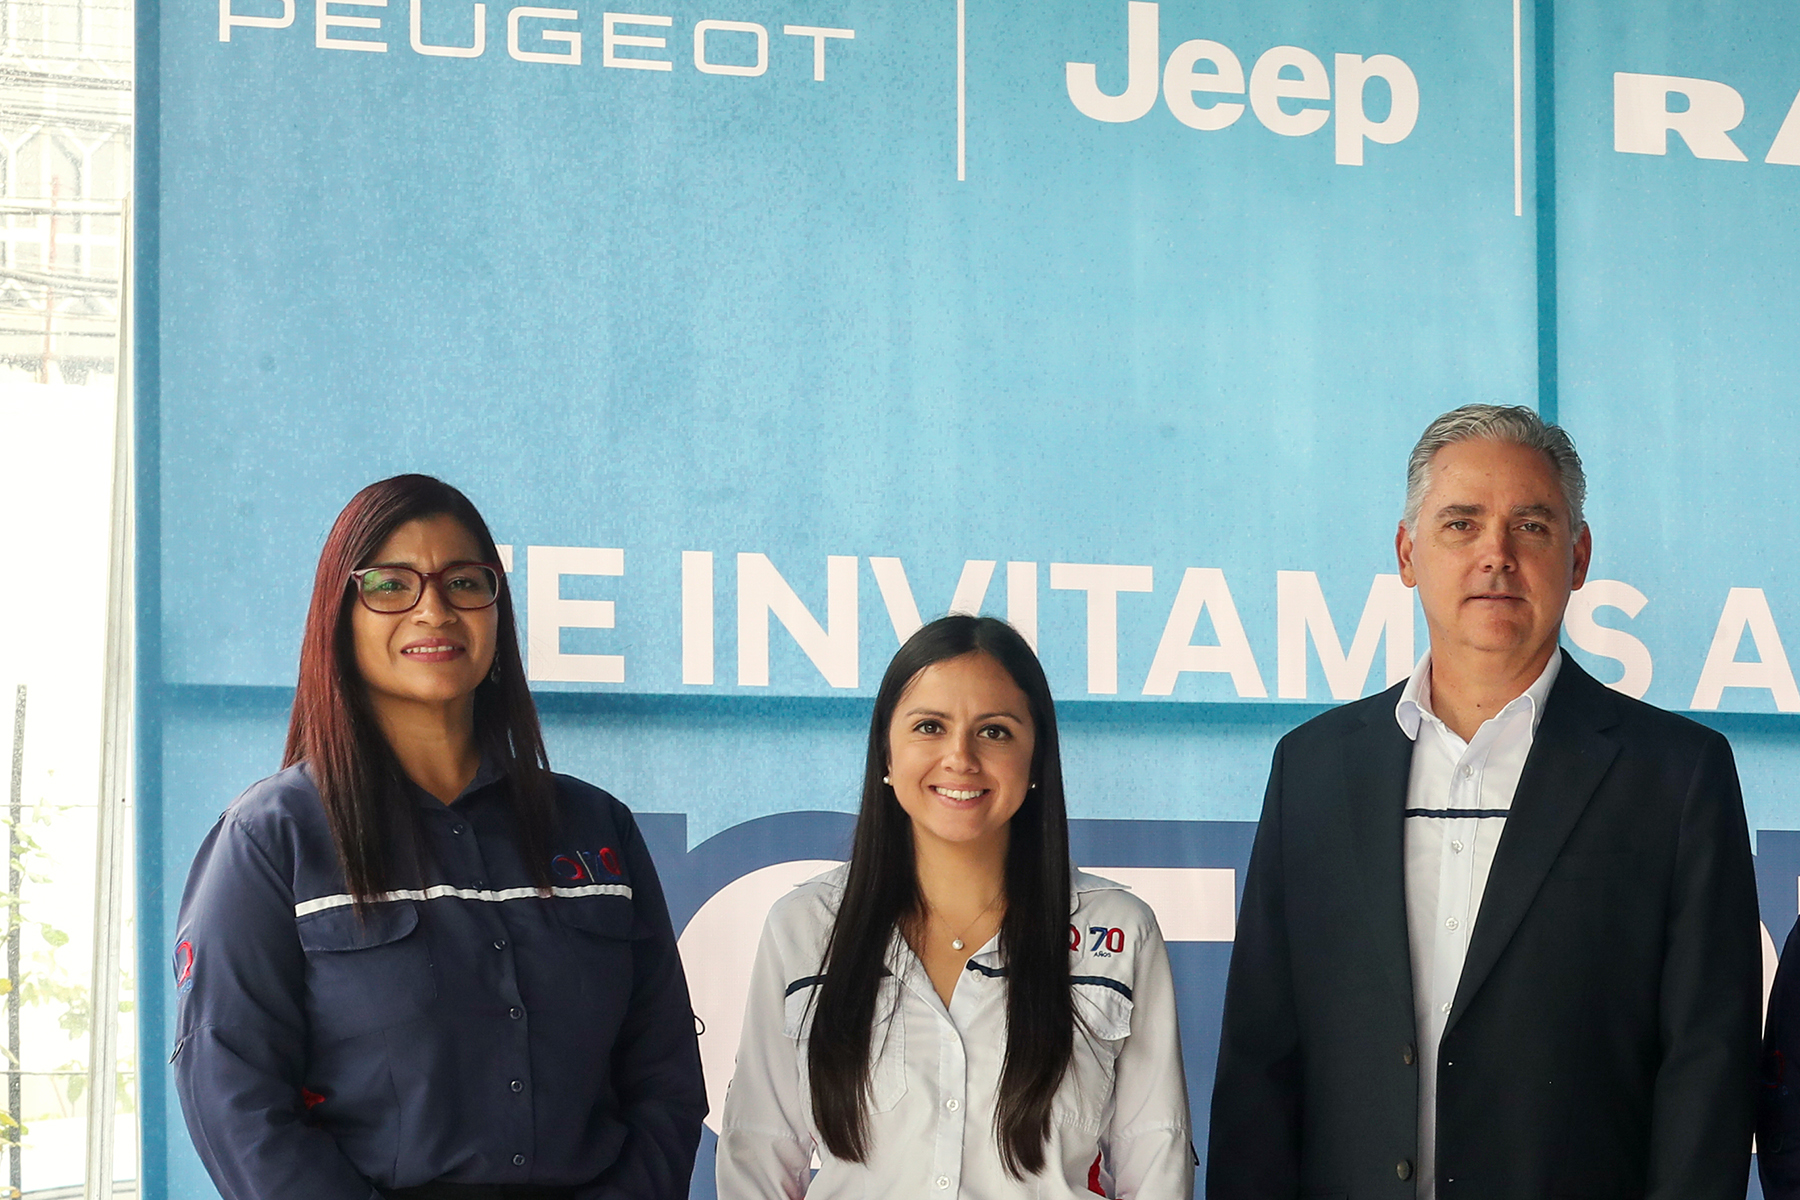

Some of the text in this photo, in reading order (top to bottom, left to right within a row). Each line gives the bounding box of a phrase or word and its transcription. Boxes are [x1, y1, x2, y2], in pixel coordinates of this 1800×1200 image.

[219, 0, 855, 82] PEUGEOT
[1066, 1, 1419, 166] Jeep
[495, 544, 625, 683] E
[682, 550, 1653, 700] INVITAMS
[1089, 926, 1125, 953] 70
